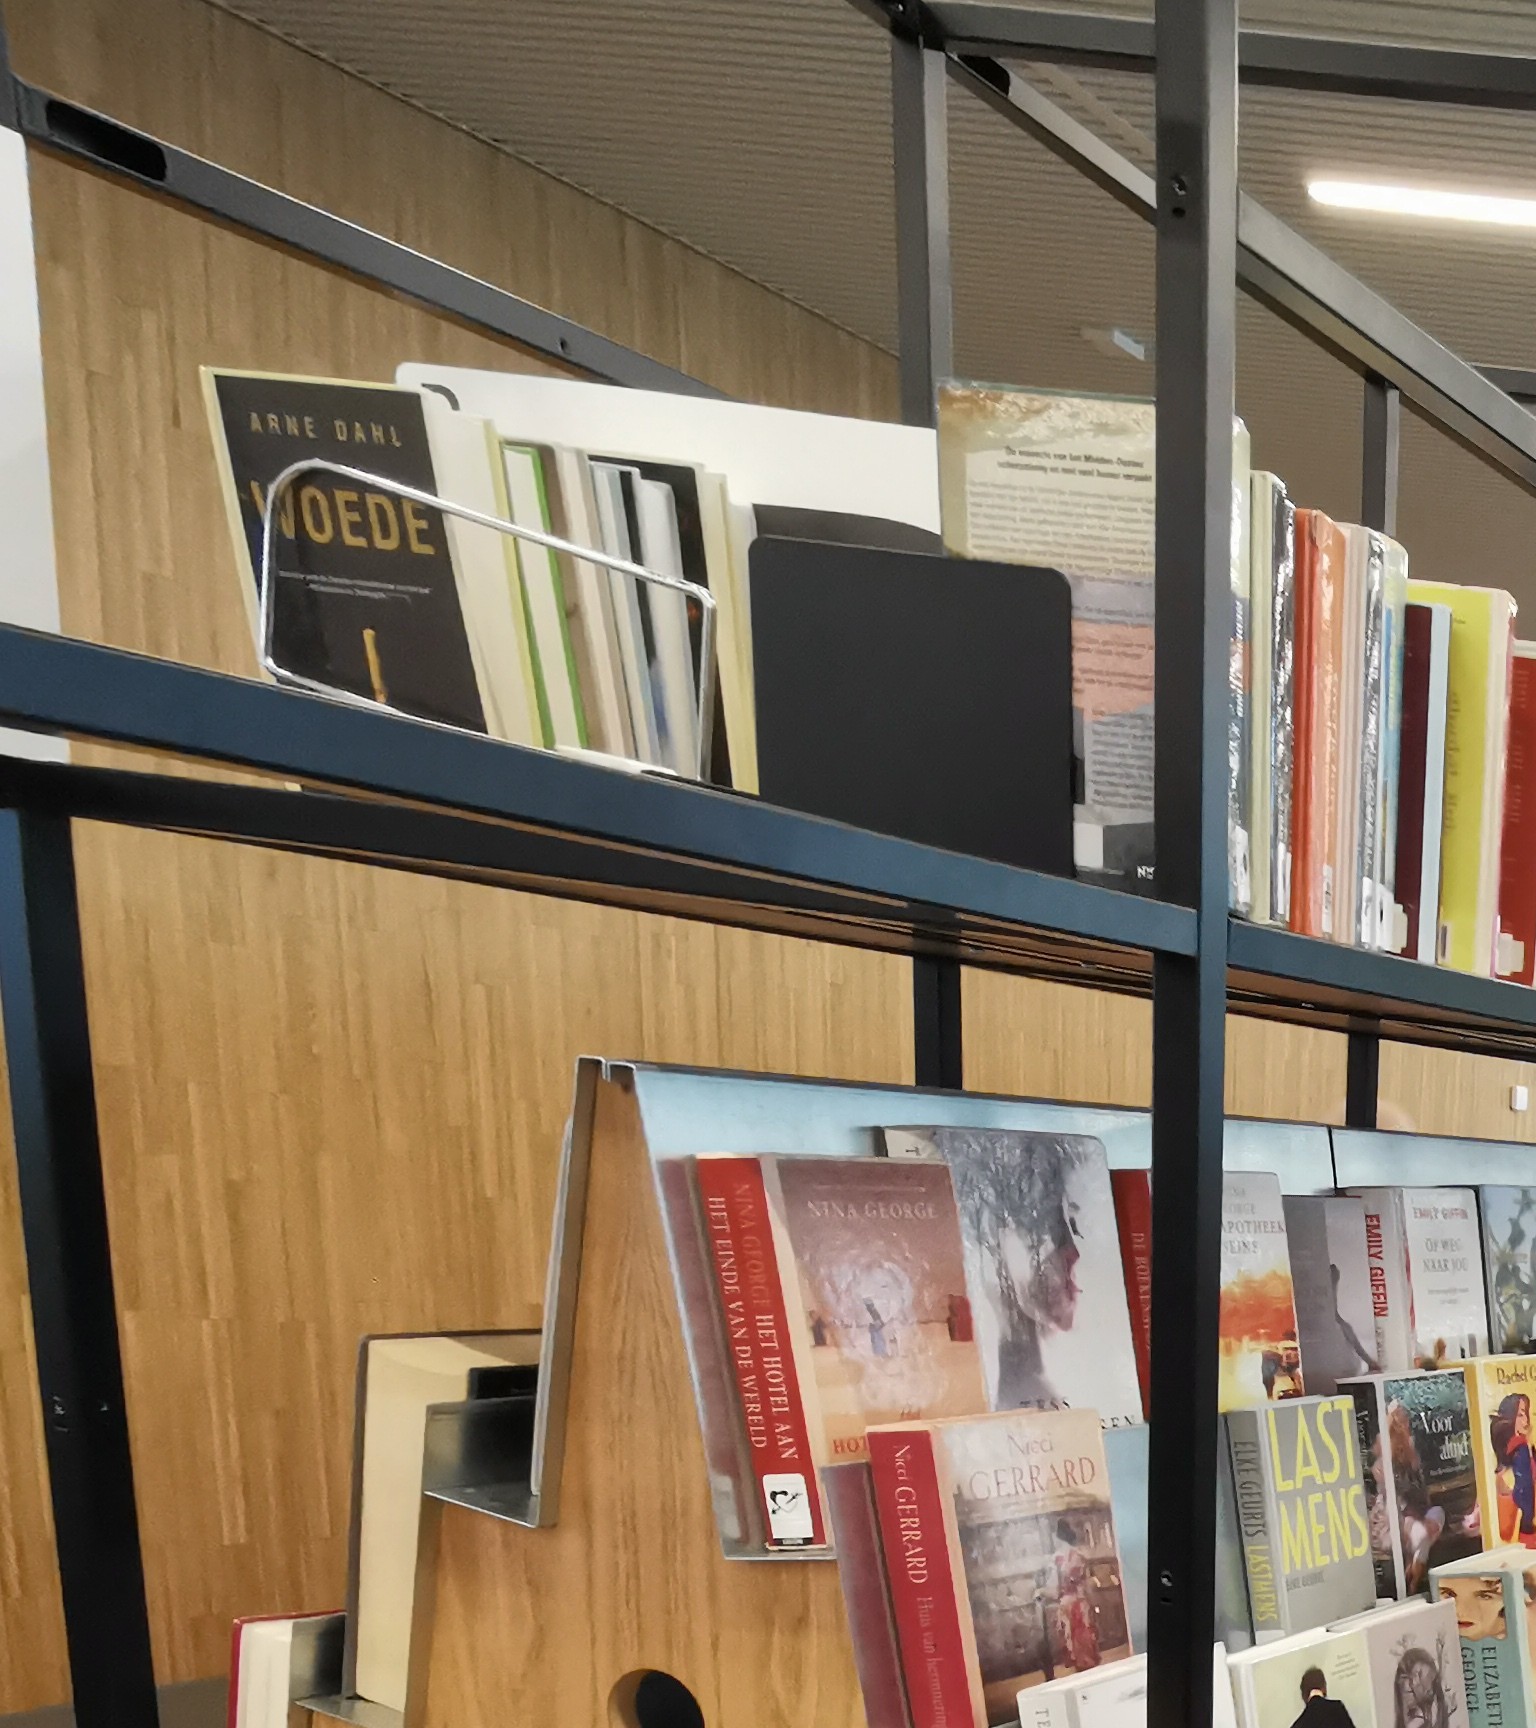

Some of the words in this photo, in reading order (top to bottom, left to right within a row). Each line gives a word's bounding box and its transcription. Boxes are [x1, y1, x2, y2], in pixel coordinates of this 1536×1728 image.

[249, 411, 318, 439] ARNE
[333, 419, 401, 448] DAHL
[250, 480, 435, 555] WOEDE
[709, 1196, 730, 1234] HET
[733, 1184, 757, 1229] NINA
[807, 1201, 857, 1218] NINA
[864, 1202, 938, 1220] GEORGE
[1365, 1213, 1384, 1261] EMILY
[715, 1240, 739, 1295] EINDE
[742, 1236, 770, 1309] GEORGE
[1369, 1266, 1389, 1318] GIFFIN
[725, 1301, 749, 1340] VAN
[756, 1314, 778, 1350] HET
[736, 1347, 753, 1370] DE
[1497, 1365, 1528, 1385] Rachel
[763, 1357, 789, 1417] HOTEL
[741, 1376, 767, 1449] WERELD
[1420, 1411, 1454, 1435] Voor
[775, 1424, 799, 1460] AAN
[833, 1435, 868, 1456] HOT
[892, 1444, 912, 1480] Nicci
[1007, 1433, 1054, 1458] Nicci
[1234, 1441, 1259, 1478] ELKE
[1267, 1400, 1354, 1492] LAST
[969, 1456, 1096, 1500] GERRARD
[894, 1486, 929, 1584] GERRARD
[1280, 1484, 1369, 1575] MENS
[1461, 1646, 1479, 1714] GEORGE
